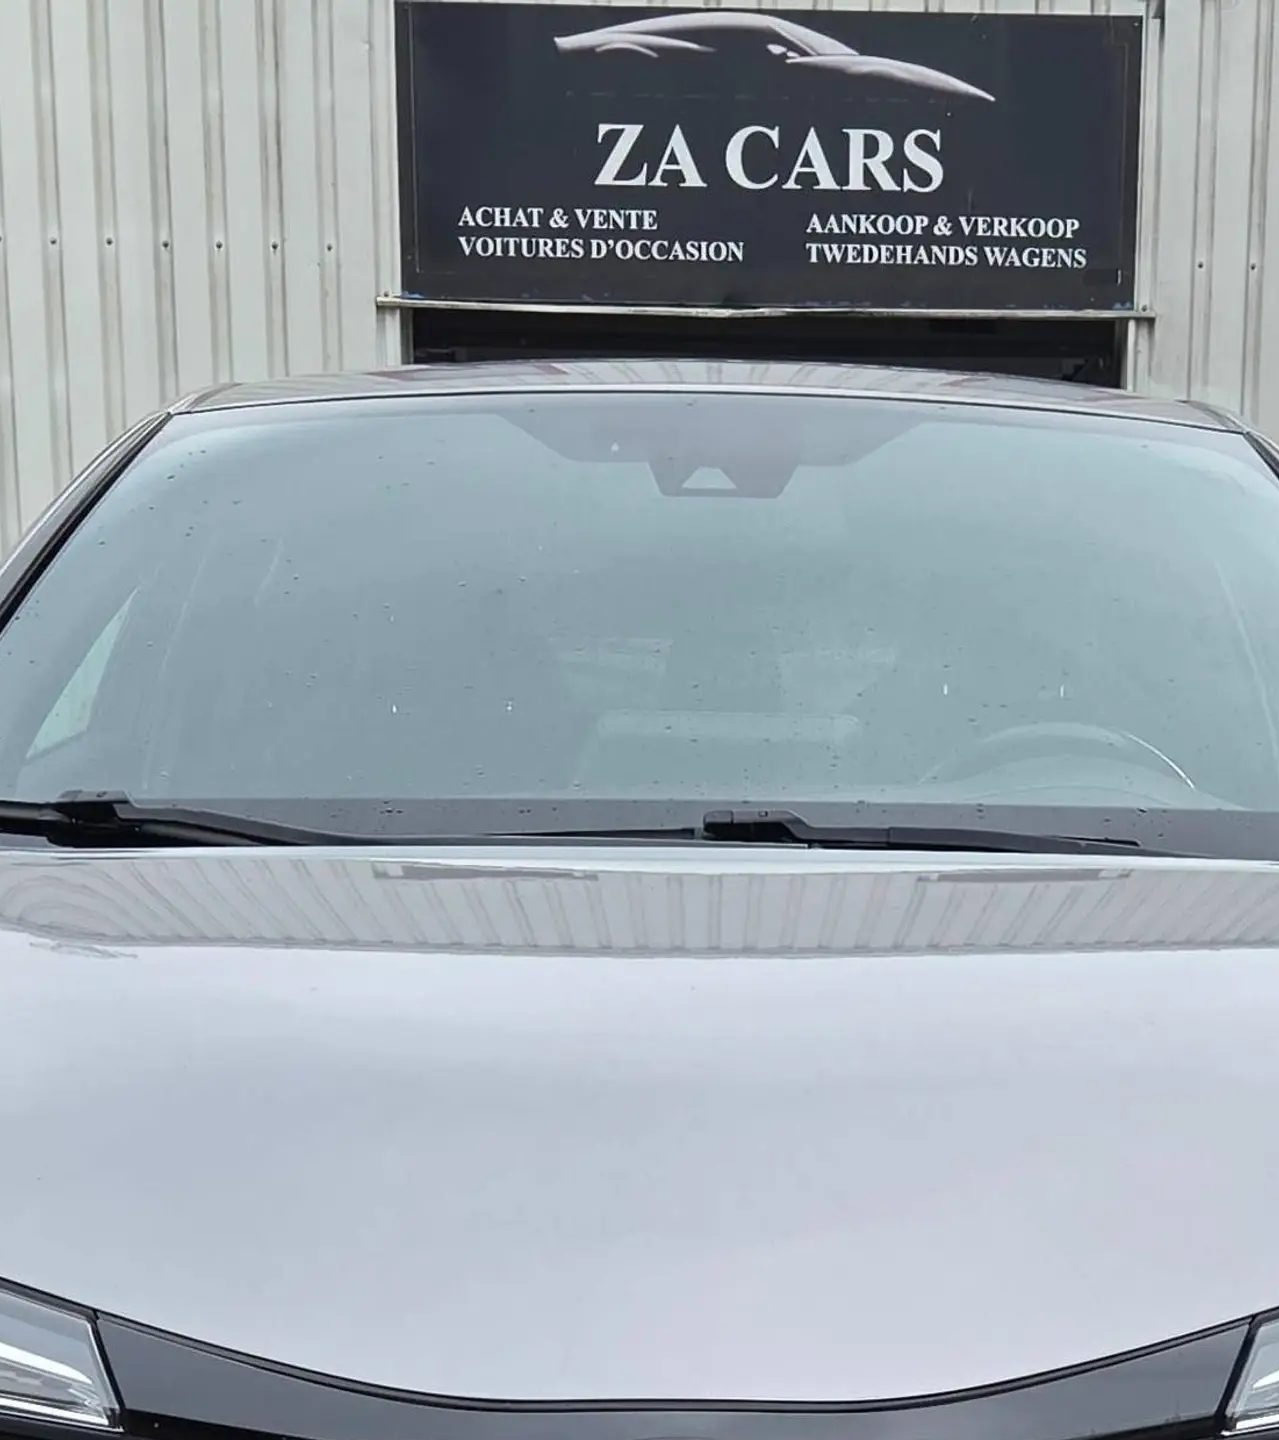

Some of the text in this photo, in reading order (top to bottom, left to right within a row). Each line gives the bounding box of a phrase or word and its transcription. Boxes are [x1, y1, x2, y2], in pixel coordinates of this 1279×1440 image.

[594, 123, 944, 192] ZA CARS
[458, 206, 657, 230] ACHAT & VENTE
[806, 213, 1080, 239] AANKOOP & VERKOOP
[458, 236, 584, 259] VOITURES
[806, 243, 1087, 269] TWEDEHANDS WAGENS
